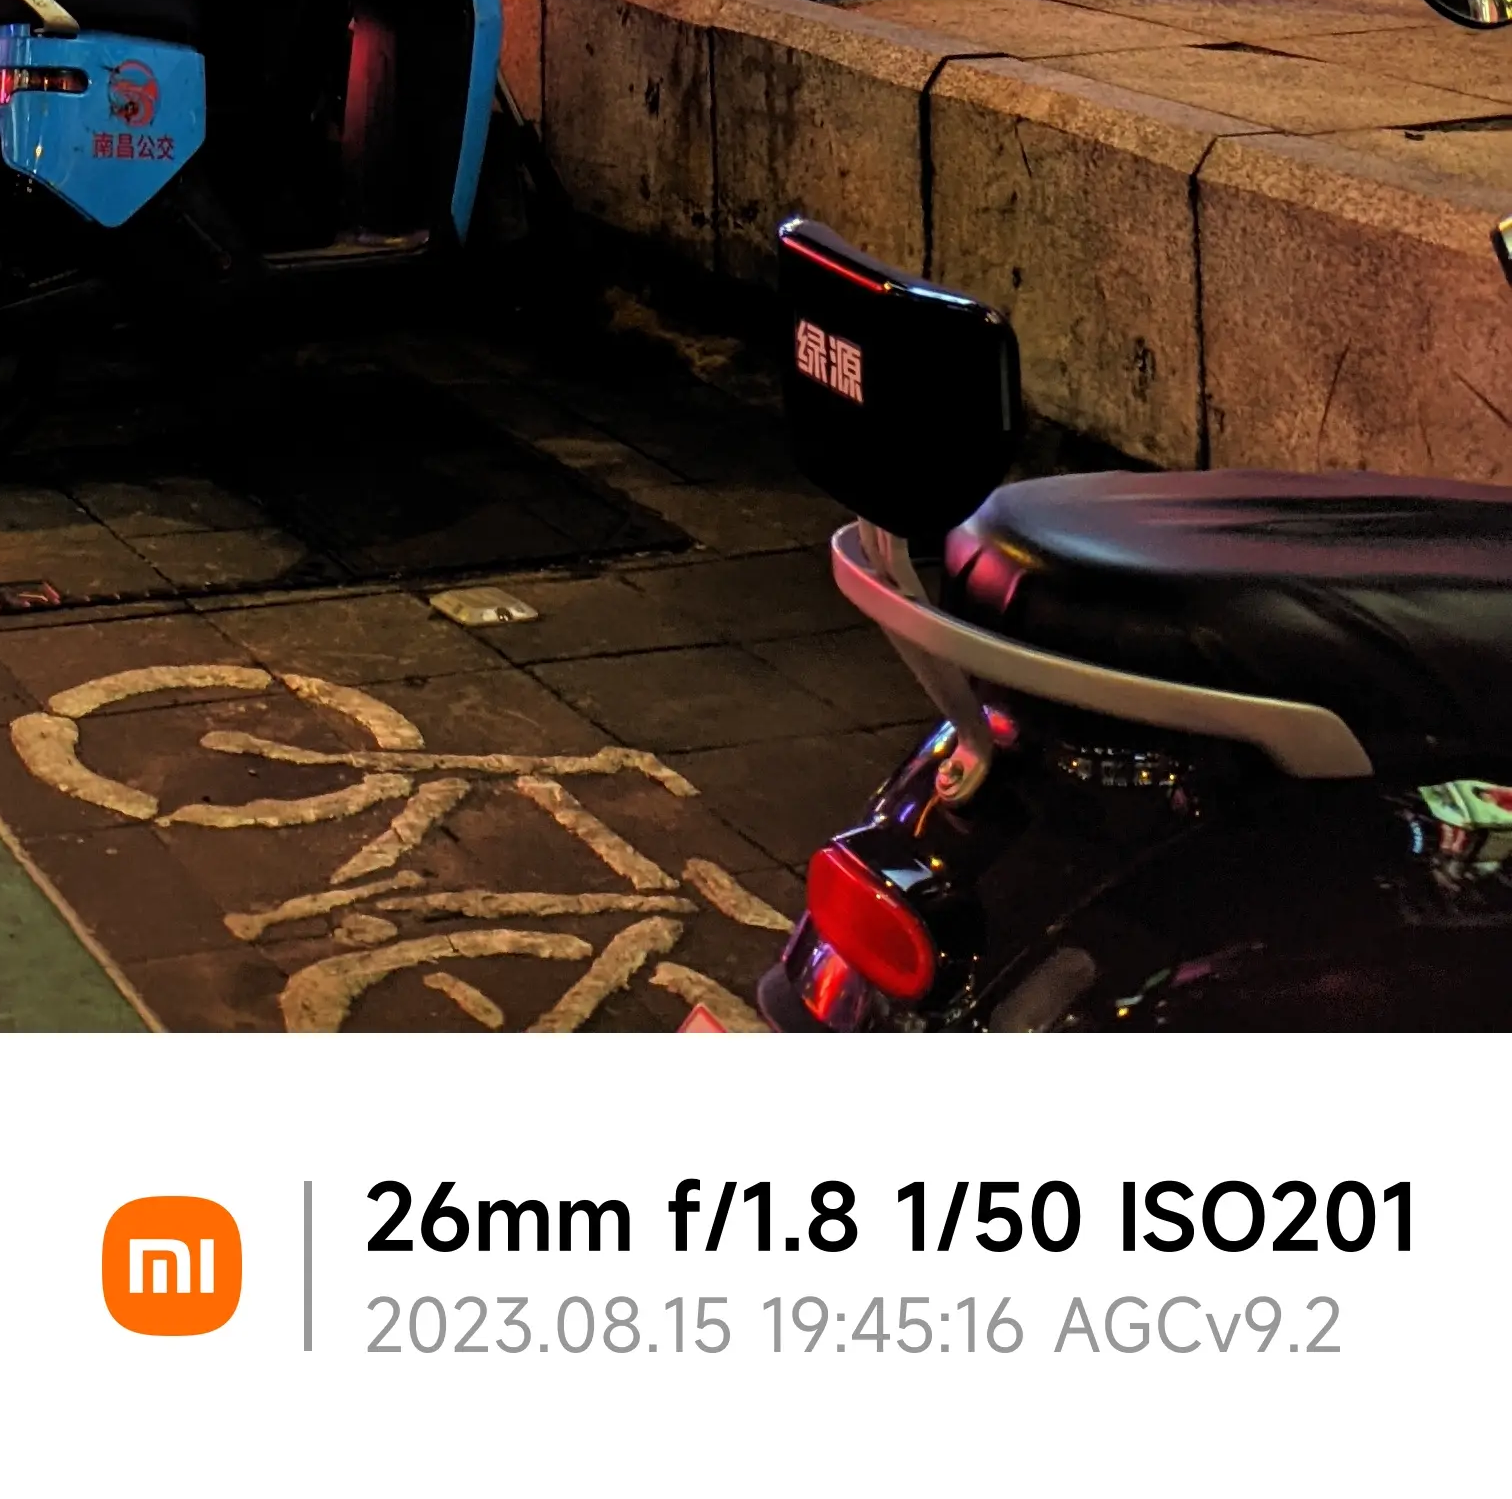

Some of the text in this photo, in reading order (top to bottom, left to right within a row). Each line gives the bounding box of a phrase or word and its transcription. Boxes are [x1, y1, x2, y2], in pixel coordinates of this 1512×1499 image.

[92, 131, 176, 160] 南昌公交
[796, 318, 864, 404] 绿源
